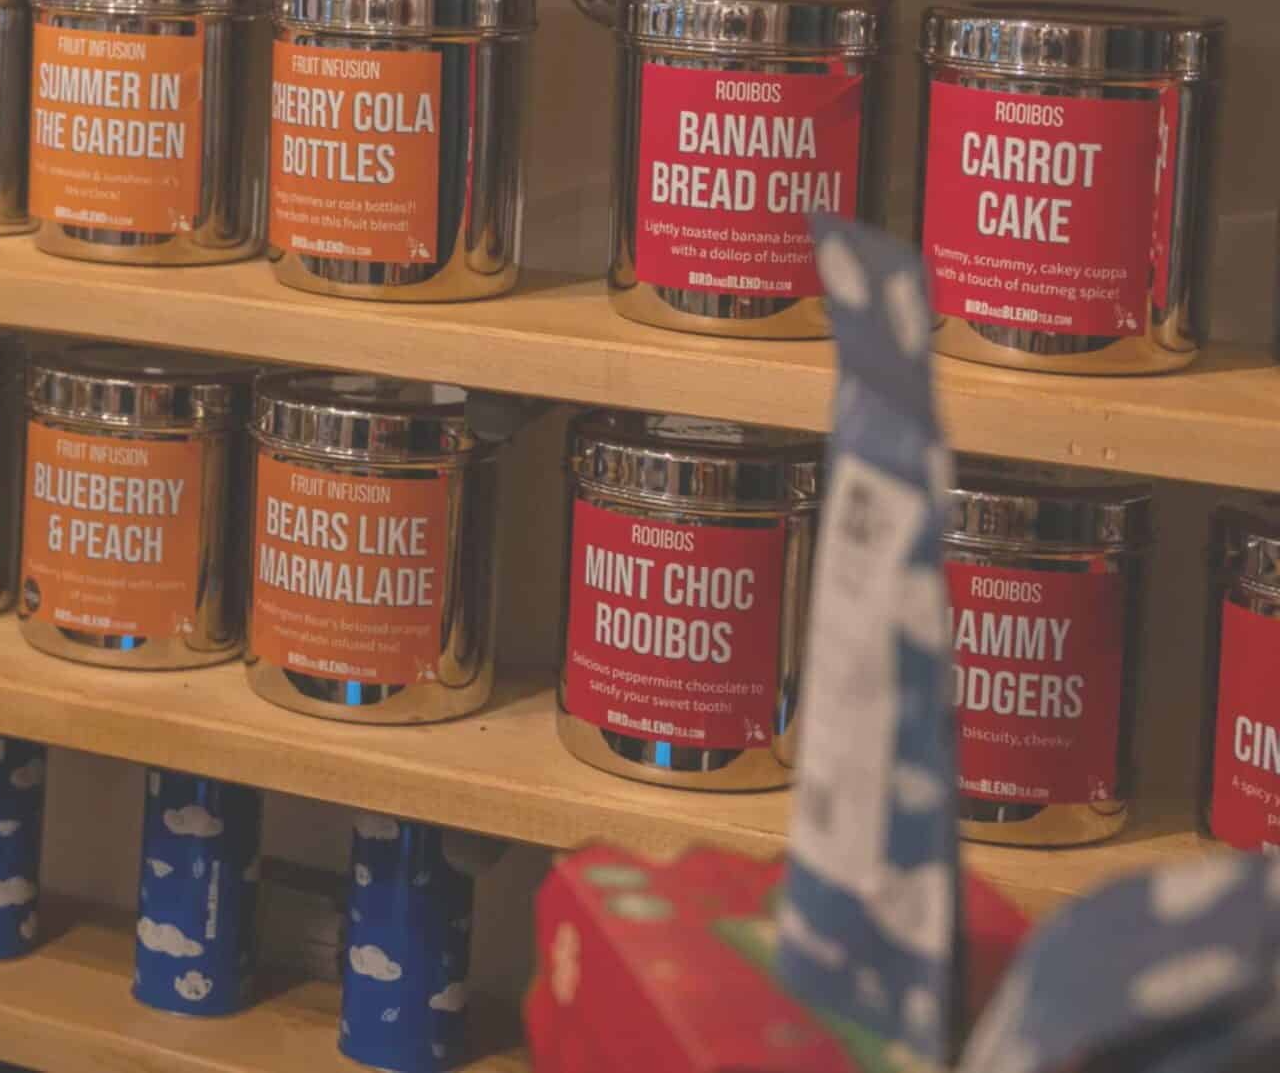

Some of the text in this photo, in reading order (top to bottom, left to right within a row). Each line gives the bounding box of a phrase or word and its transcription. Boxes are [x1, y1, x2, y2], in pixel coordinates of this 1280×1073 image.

[88, 40, 146, 60] INFUSION
[292, 55, 380, 80] FRUIT INFUSION
[39, 62, 180, 111] SUMMER IN
[715, 79, 782, 103] ROOIBOS
[353, 91, 435, 133] COLA
[995, 101, 1064, 127] ROOIBOS
[35, 108, 185, 159] THE GARDEN
[678, 110, 817, 159] BANANA
[283, 134, 396, 184] BOTTLES
[961, 131, 1102, 187] CARROT
[652, 161, 841, 214] BREAD CHAI
[644, 220, 816, 245] Lightly toasted banana brea
[977, 191, 1072, 245] CAKE
[671, 245, 813, 264] with a dollop of butter!
[973, 254, 1038, 275] scrummy,
[1040, 263, 1081, 278] cakey
[1084, 267, 1128, 281] cuppa
[936, 267, 1120, 301] with a touch of nutmeg spice!
[89, 444, 149, 466] INFUSION
[34, 462, 184, 515] BLUEBERRY
[290, 473, 391, 504] FRUIT INFUSION
[48, 513, 163, 563] & PEACH
[266, 496, 428, 556] BEARS LIKE
[631, 524, 695, 552] ROOIBOS
[259, 543, 435, 607] MARMALADE
[585, 544, 755, 611] MINT CHOC
[971, 576, 1043, 604] ROOIBOS
[595, 601, 734, 664] ROOIBOS
[948, 607, 1073, 662] AMMY
[589, 679, 732, 714] satisfy your sweet tooth!
[612, 667, 683, 691] peppermint
[685, 682, 749, 695] chocolate
[962, 726, 1022, 747] biscuity,
